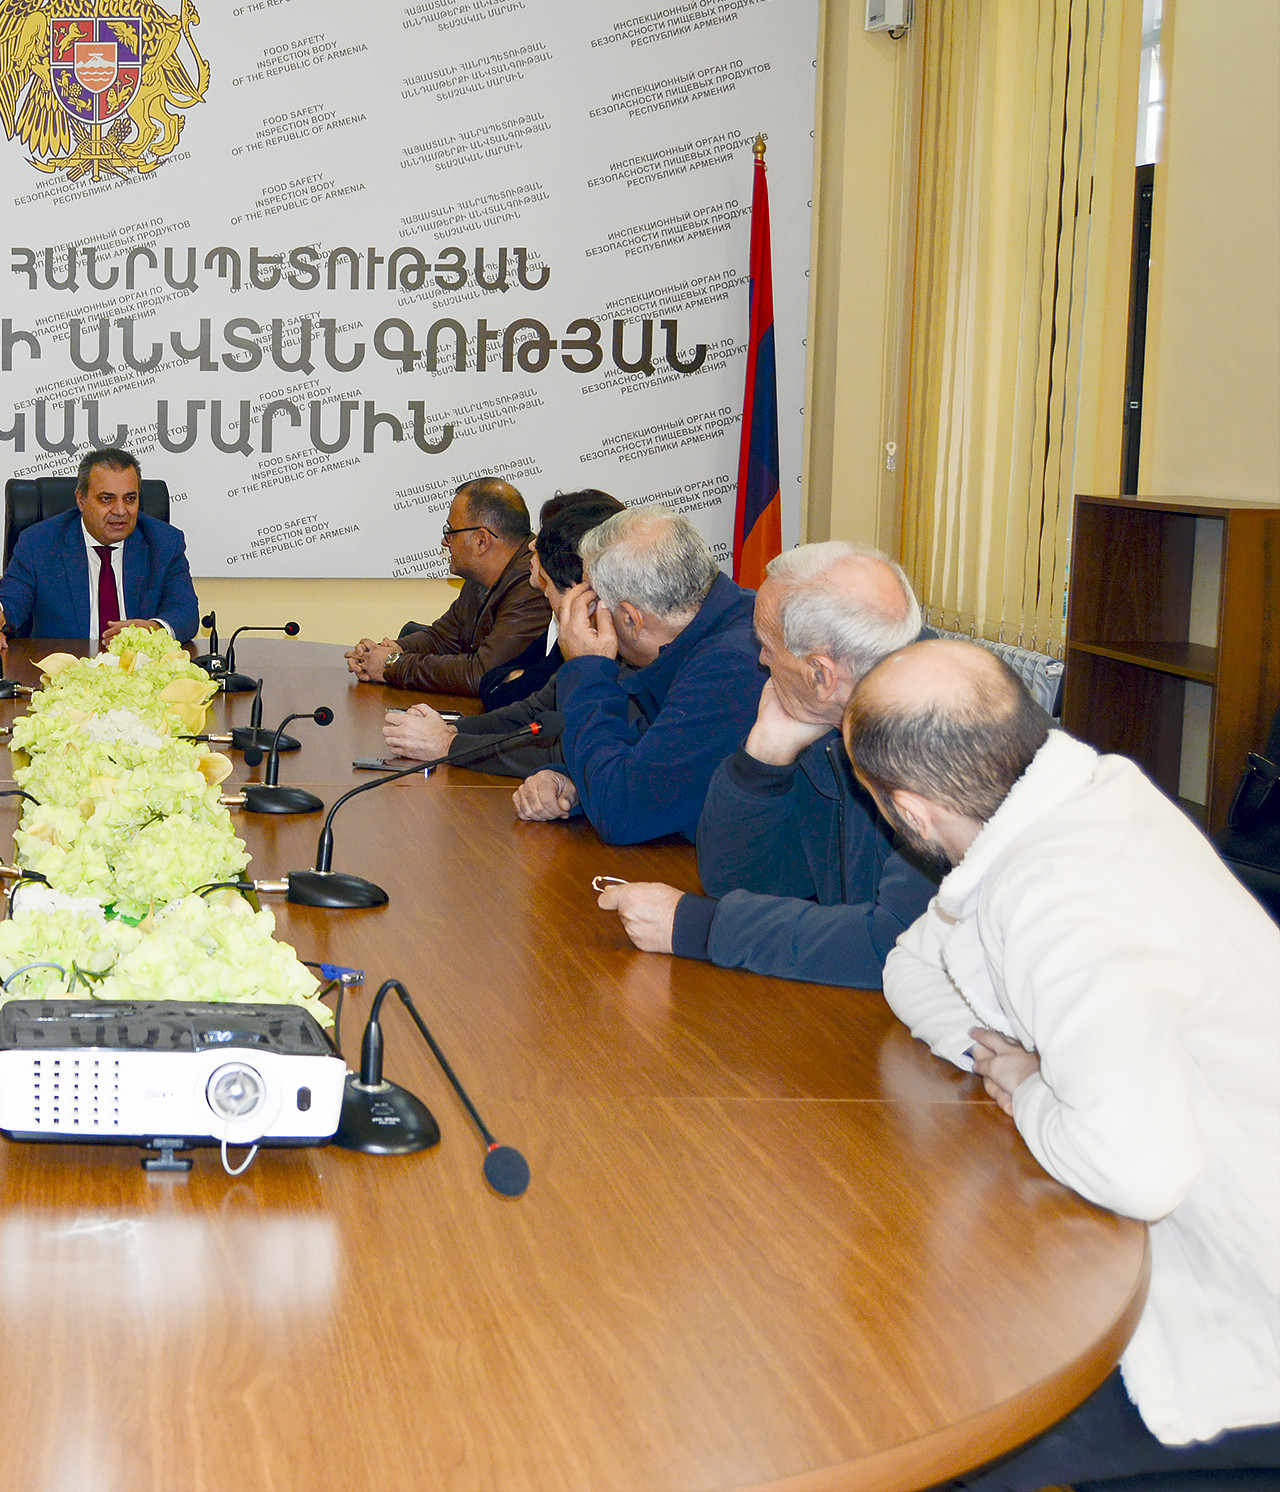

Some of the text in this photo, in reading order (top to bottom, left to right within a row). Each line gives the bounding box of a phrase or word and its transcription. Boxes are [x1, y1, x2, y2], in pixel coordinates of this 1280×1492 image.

[401, 51, 554, 99] ՍՆՆԴԱՄԹԵՐՔԻ ԱՆՎՏԱՆԳՈՒԹՅԱՆ
[402, 42, 547, 86] ՀԱՅԱՍՏԱՆԻ ՀԱՆՐԱՊԵՏՈՒԹՅԱՆ
[611, 59, 744, 102] ИНСПЕКЦИОННЫЙ ОРГАН ПО
[436, 72, 524, 101] ՏԵՍՉԱԿԱՆ ՄԱՐՄԻՆ
[589, 63, 771, 118] БЕЗОПАСНОСТИ ПИЩЕВЫХ ПРОДУКТОВ
[628, 83, 736, 118] РЕСПУБЛИКИ АРМЕНИЯ
[256, 111, 337, 139] INSPECTION BODY
[262, 103, 324, 127] FOOD SAFETY
[401, 112, 545, 156] ՀԱՅԱՍՏԱՆԻ ՀԱՆՐԱՊԵՏՈՒԹՅԱՆ
[231, 113, 367, 156] OF THE REPUBLIC OF ARMENIA
[400, 121, 552, 169] ՍՆՆԴԱՄԹԵՐՔԻ ԱՆՎՏԱՆԳՈՒԹՅԱՆ
[609, 129, 742, 172] ИНСПЕКЦИОННЫЙ ОРГАН ПО
[435, 142, 523, 171] ՏԵՍՉԱԿԱՆ ՄԱՐՄԻՆ
[587, 149, 712, 188] БЕЗОПАСНОСТИ ПИЩЕВЫХ
[626, 153, 734, 188] РЕСПУБЛИКИ АРМЕНИЯ
[53, 184, 111, 206] РЕСПУБЛИКИ
[255, 180, 336, 208] INSPECTION BODY
[261, 172, 323, 196] FOOD SAFETY
[230, 182, 366, 225] OF THE REPUBLIC OF ARMENIA
[399, 190, 550, 239] ՍՆՆԴԱՄԹԵՐՔԻ ԱՆՎՏԱՆԳՈՒԹՅԱՆ
[400, 181, 543, 226] ՀԱՅԱՍՏԱՆԻ ՀԱՆՐԱՊԵՏՈՒԹՅԱՆ
[120, 217, 164, 236] ОРГАН ПО
[137, 220, 190, 241] ПРОДУКТОВ
[433, 211, 521, 240] ՏԵՍՉԱԿԱՆ ՄԱՐՄԻՆ
[11, 246, 551, 294] ՀԱՆՐԱՊԵՏՈՒԹՅԱՆ
[36, 289, 148, 327] ИНСПЕКЦИОННЫЙ ОРГАН
[70, 317, 708, 377] ԱՆՎՏԱՆԳՈՒԹՅԱՆ
[113, 376, 156, 395] АРМЕНИЯ
[157, 399, 454, 457] ՄԱՐՄԻՆ
[226, 523, 360, 565] OF THE REPUBLIC OF ARMENIA
[250, 522, 331, 549] INSPECTION BODY
[256, 514, 318, 537] FOOD SAFETY
